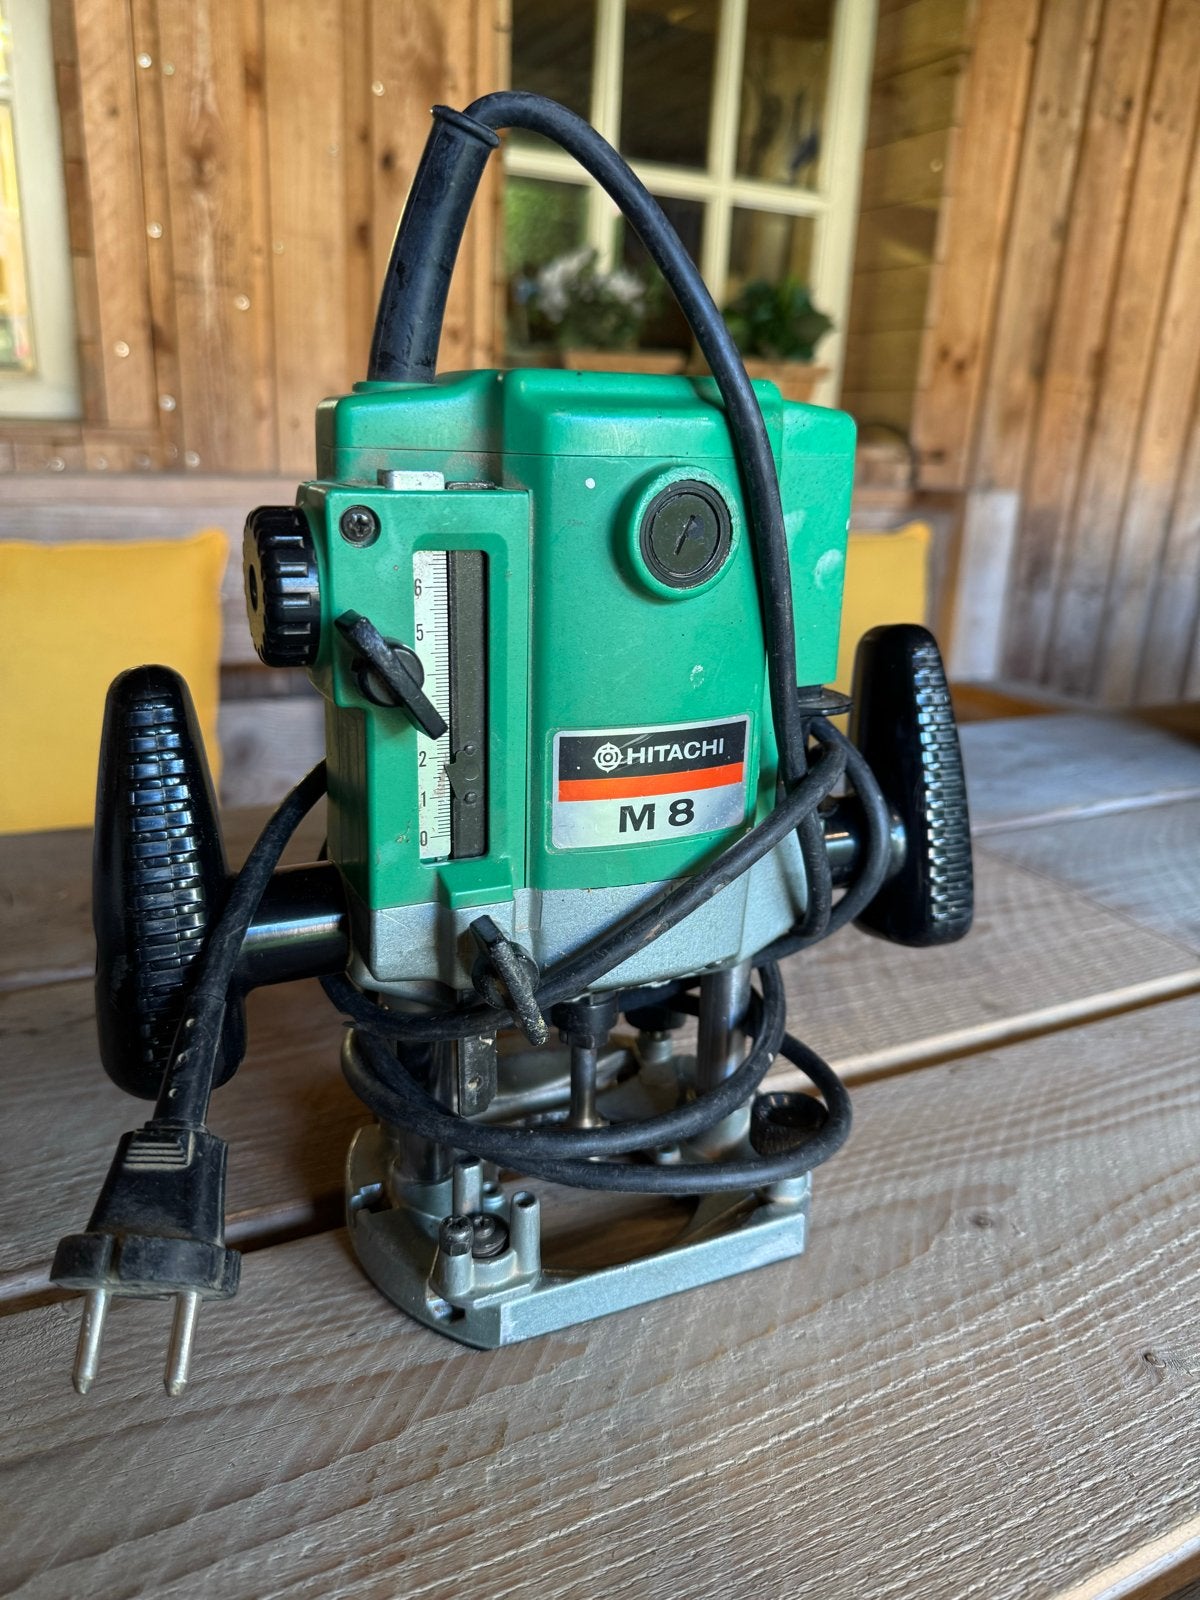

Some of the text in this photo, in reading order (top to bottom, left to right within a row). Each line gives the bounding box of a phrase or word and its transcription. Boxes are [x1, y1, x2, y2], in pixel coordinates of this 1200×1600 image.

[414, 578, 422, 596] 6
[416, 624, 424, 641] 5
[419, 751, 427, 767] 2
[627, 738, 724, 764] HITACHI
[420, 791, 427, 807] 1
[619, 798, 695, 832] M 8
[420, 831, 428, 846] 0
